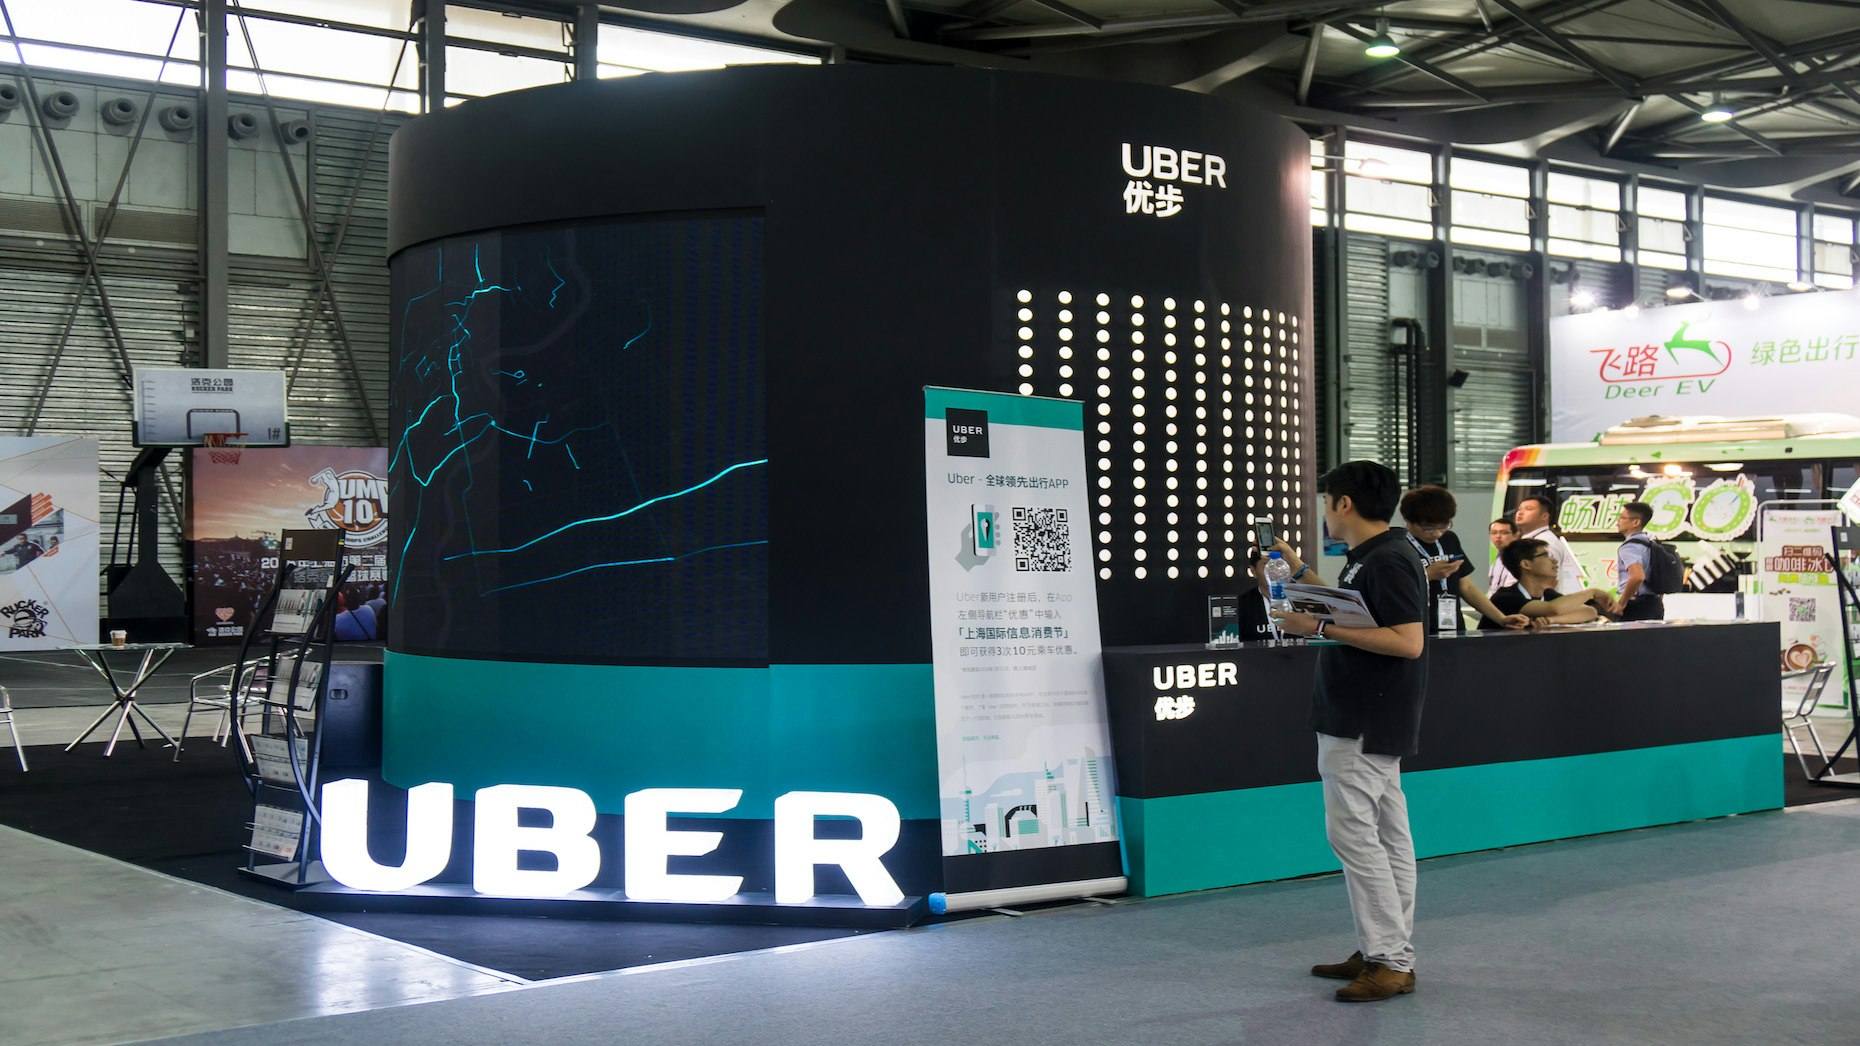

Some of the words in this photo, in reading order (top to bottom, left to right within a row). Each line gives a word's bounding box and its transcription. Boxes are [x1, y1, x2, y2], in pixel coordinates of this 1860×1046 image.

[1121, 142, 1227, 189] UBER
[1123, 180, 1184, 218] 优步
[1589, 344, 1660, 382] 飞路
[1750, 334, 1860, 367] 绿色出行
[1605, 383, 1664, 400] Deer
[1676, 378, 1716, 395] EV
[952, 424, 983, 436] UBER
[953, 436, 968, 444] 优步
[948, 473, 975, 484] Uber
[986, 475, 1069, 489] 全球领先出行APP
[343, 500, 374, 525] 10
[1640, 478, 1752, 535] GO
[0, 598, 50, 619] RUCKER
[8, 627, 46, 639] PARK
[1153, 662, 1238, 690] UBER
[1154, 695, 1196, 721] 优步
[320, 777, 905, 907] UBER
